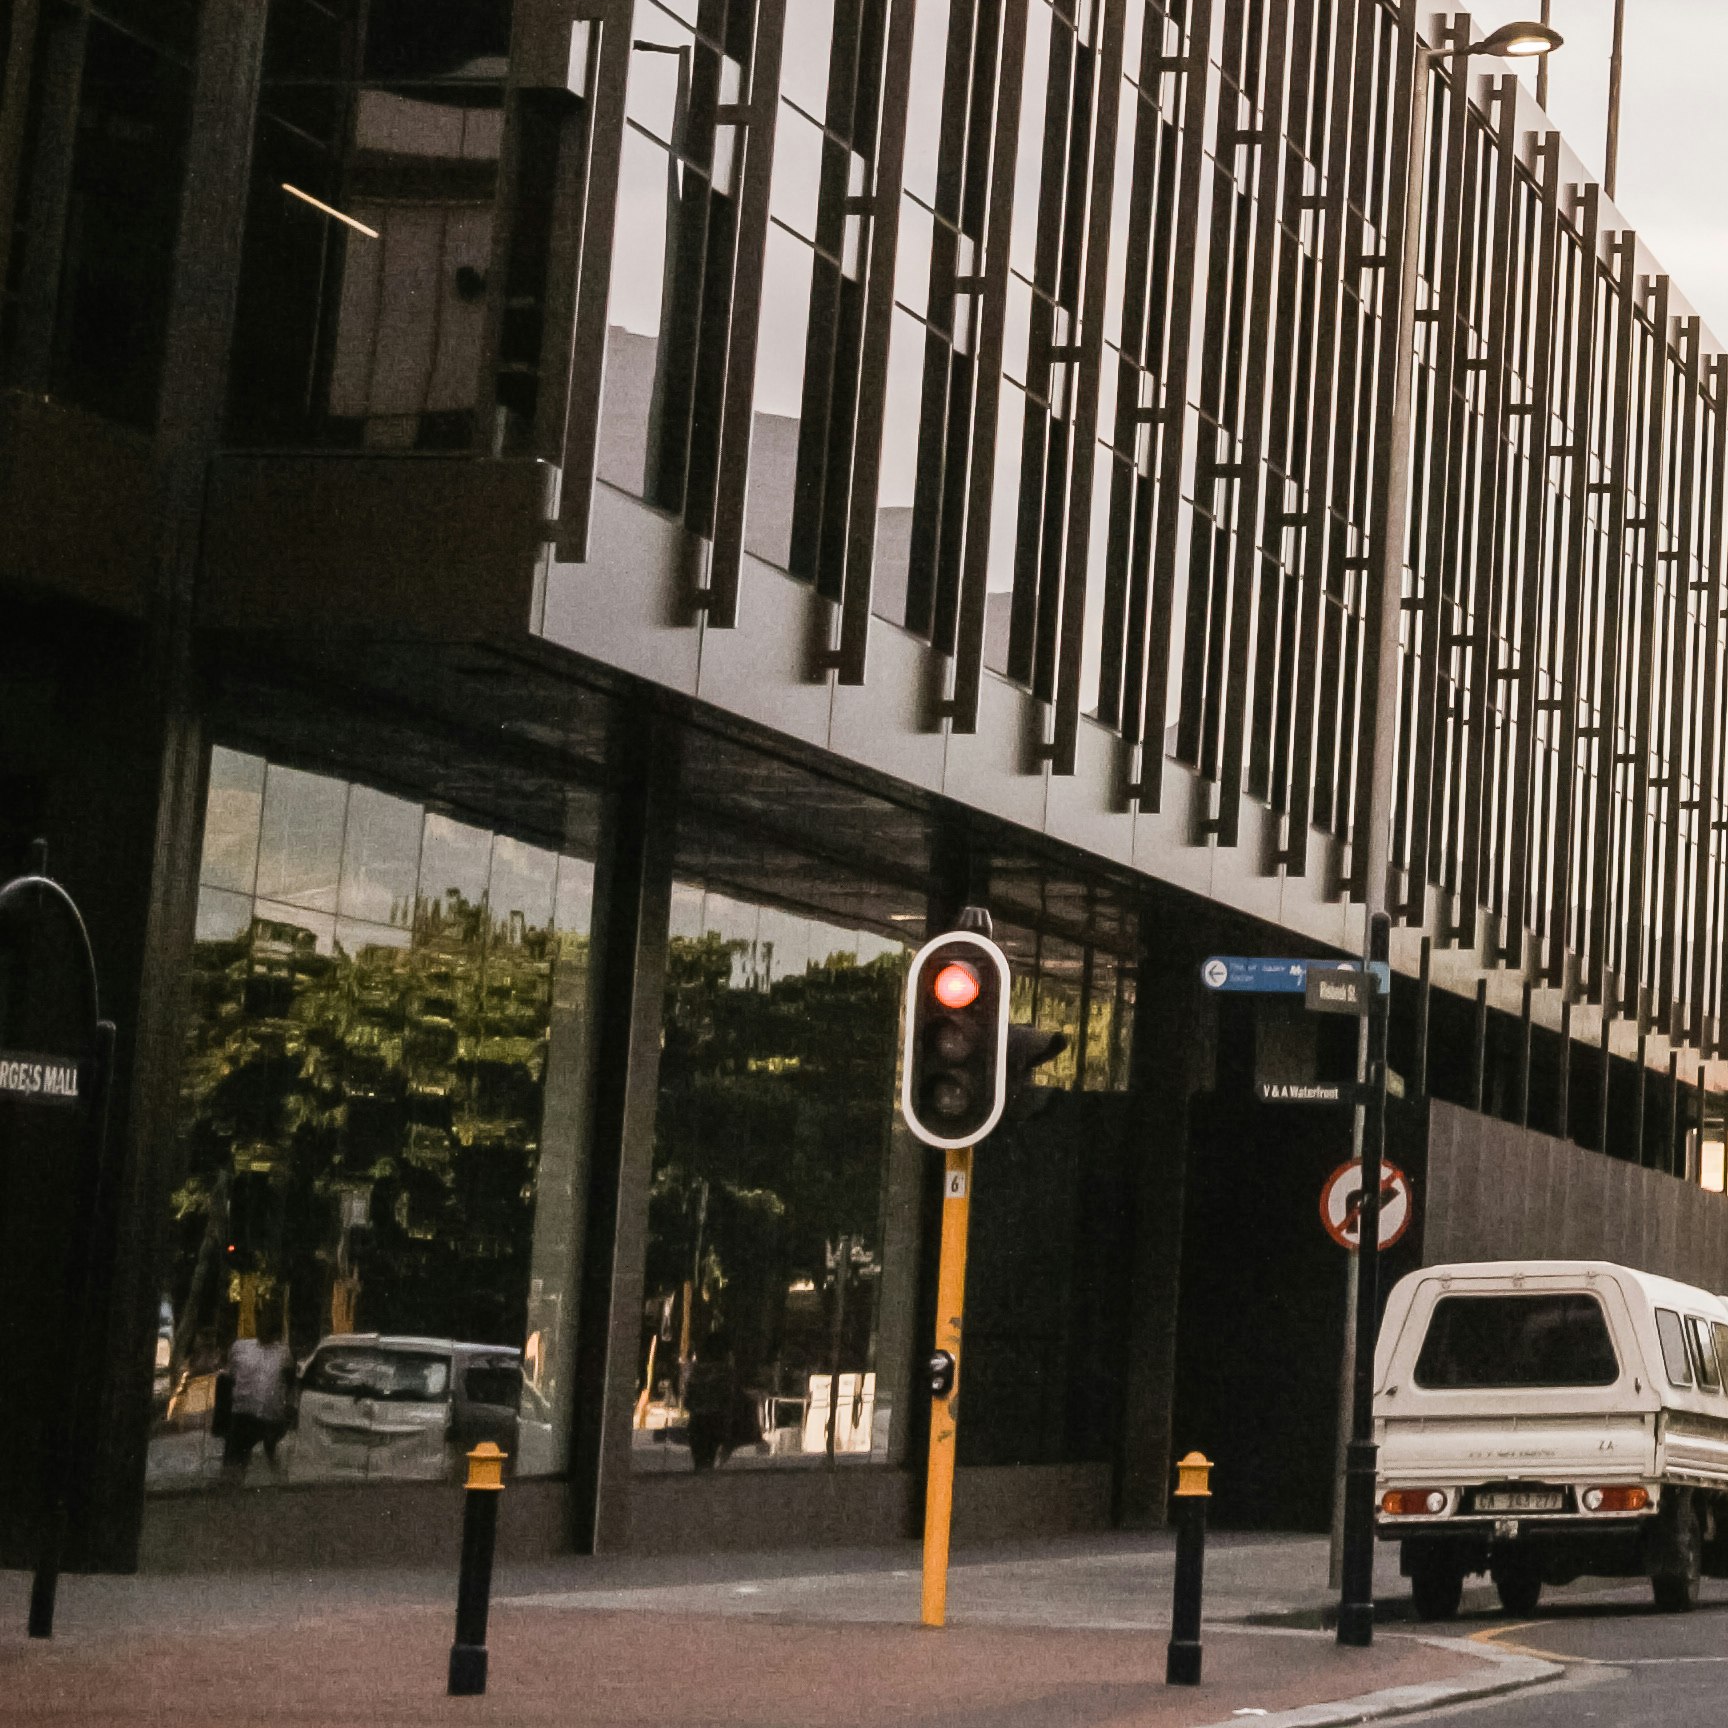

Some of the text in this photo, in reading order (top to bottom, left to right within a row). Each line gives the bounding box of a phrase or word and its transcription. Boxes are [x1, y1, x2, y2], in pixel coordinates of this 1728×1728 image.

[44, 1065, 78, 1096] MALL
[1263, 1084, 1338, 1099] V & A Waterfront
[951, 1175, 959, 1193] 6
